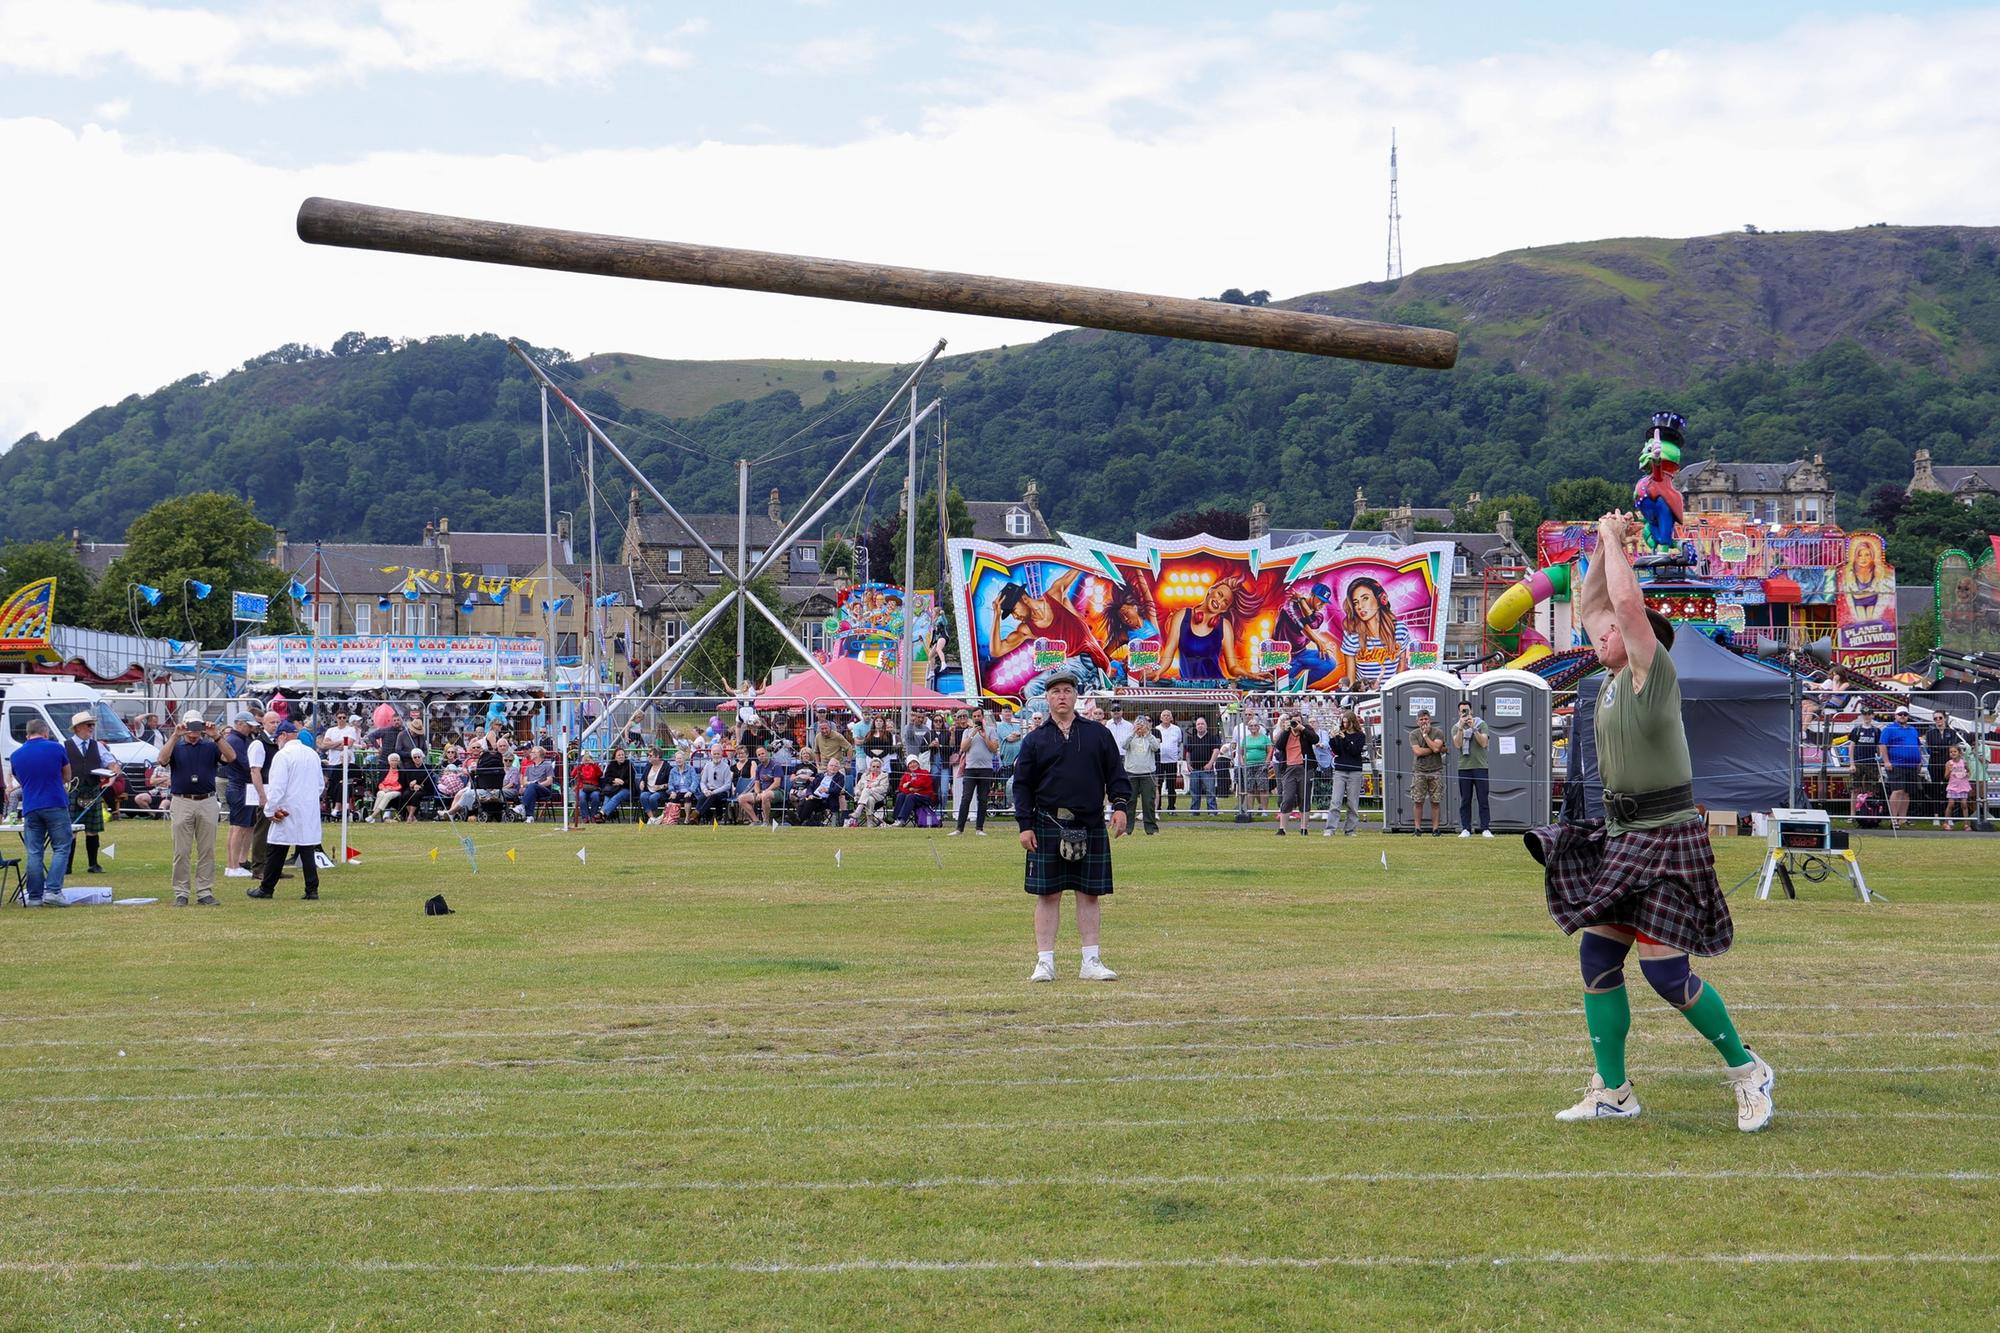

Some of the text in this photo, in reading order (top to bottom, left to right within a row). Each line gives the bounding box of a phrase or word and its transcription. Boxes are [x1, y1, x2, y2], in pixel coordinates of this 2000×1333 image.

[1845, 624, 1884, 638] PLANET
[284, 639, 307, 649] TIN
[342, 639, 381, 649] ALLEY
[391, 639, 493, 650] TIN CAN ALLEY
[1849, 632, 1896, 647] HOLLYWOOD
[1036, 640, 1065, 651] SOUND
[1129, 641, 1159, 652] SOUND
[1261, 642, 1290, 652] SOUND
[285, 654, 310, 663] WIN
[340, 654, 381, 663] PRIZES
[391, 654, 493, 664] WIN BIG PRIZES
[1842, 652, 1891, 668] 4 FLOORS
[1869, 664, 1892, 678] FUN
[316, 855, 329, 866] 2
